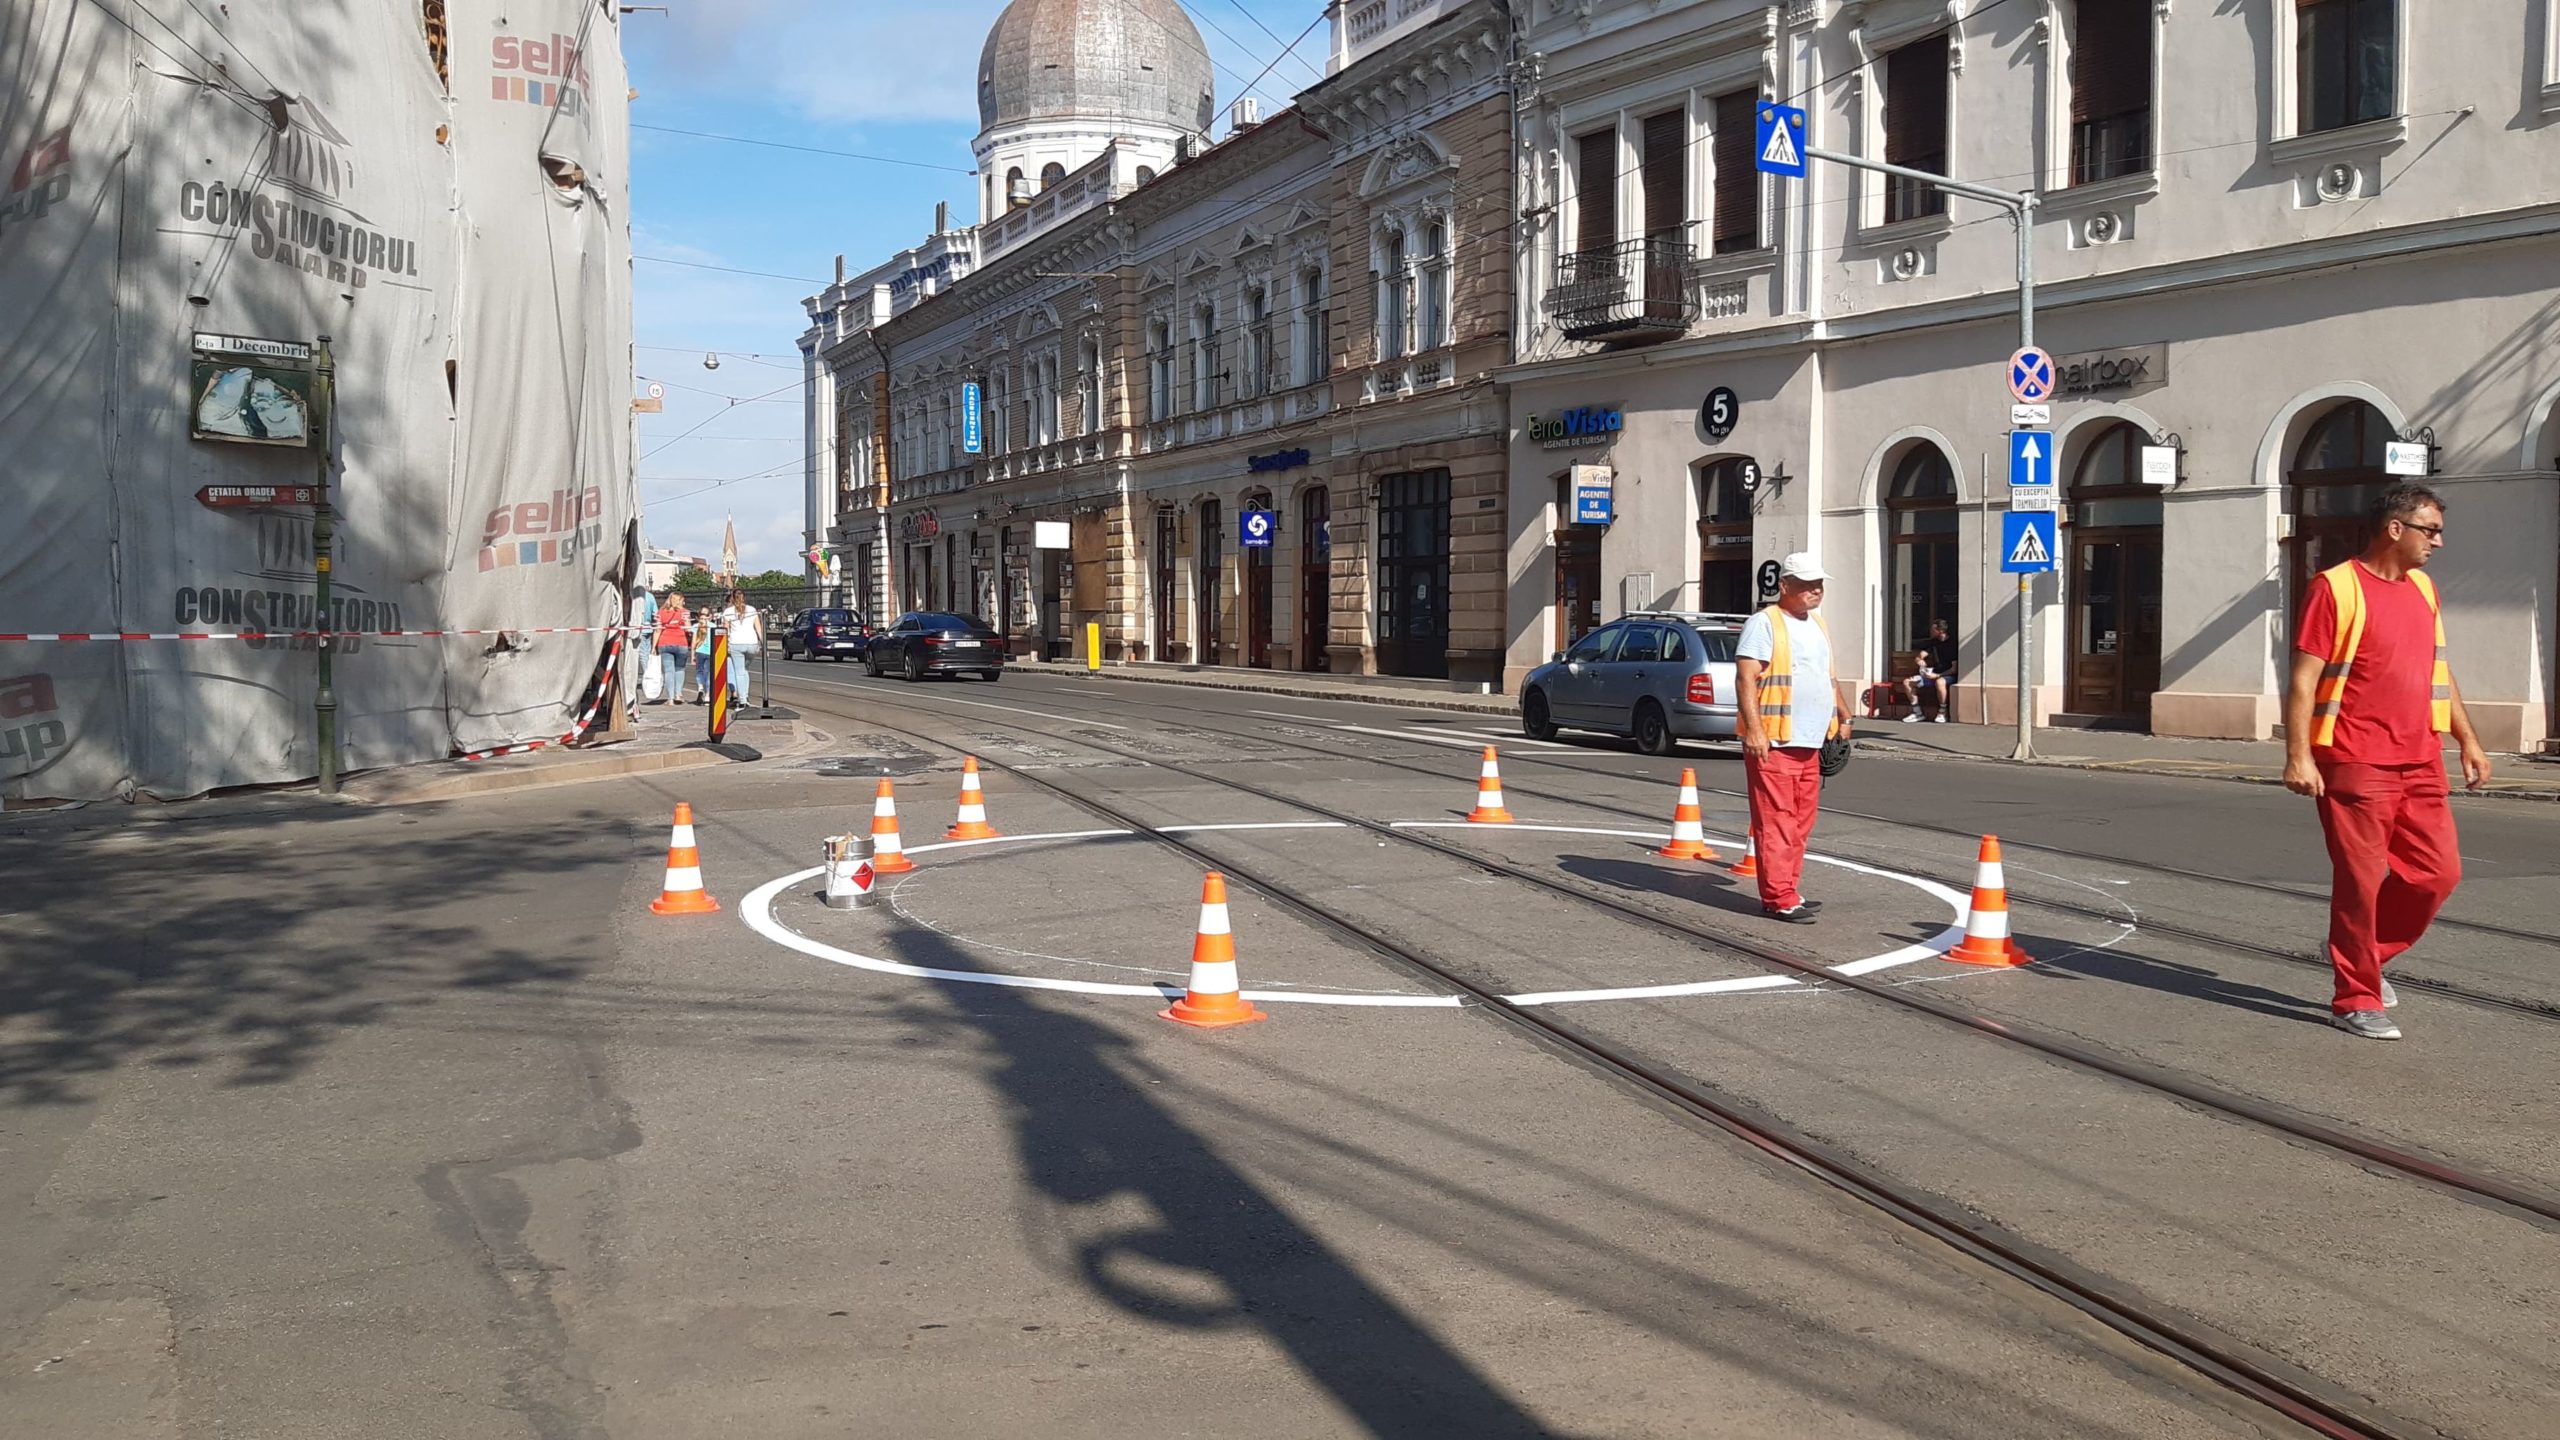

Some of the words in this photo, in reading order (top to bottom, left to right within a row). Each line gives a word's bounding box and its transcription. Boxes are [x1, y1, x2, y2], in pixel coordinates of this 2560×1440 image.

[181, 181, 418, 276] CONSTRUCTORUL
[233, 339, 309, 357] Decembrie
[1712, 393, 1728, 424] 5
[1543, 439, 1570, 448] AGENTIE
[1571, 438, 1580, 446] DE
[1581, 435, 1607, 445] TURISM
[1744, 465, 1755, 483] 5
[208, 487, 242, 497] CETATEA
[244, 487, 276, 496] ORADEA
[1580, 490, 1608, 498] AGENTIE
[2015, 488, 2023, 497] CU
[1589, 501, 1599, 509] DE
[1581, 511, 1607, 519] TURISM
[1765, 564, 1776, 587] 5
[175, 587, 404, 649] CONSTRUTORUL
